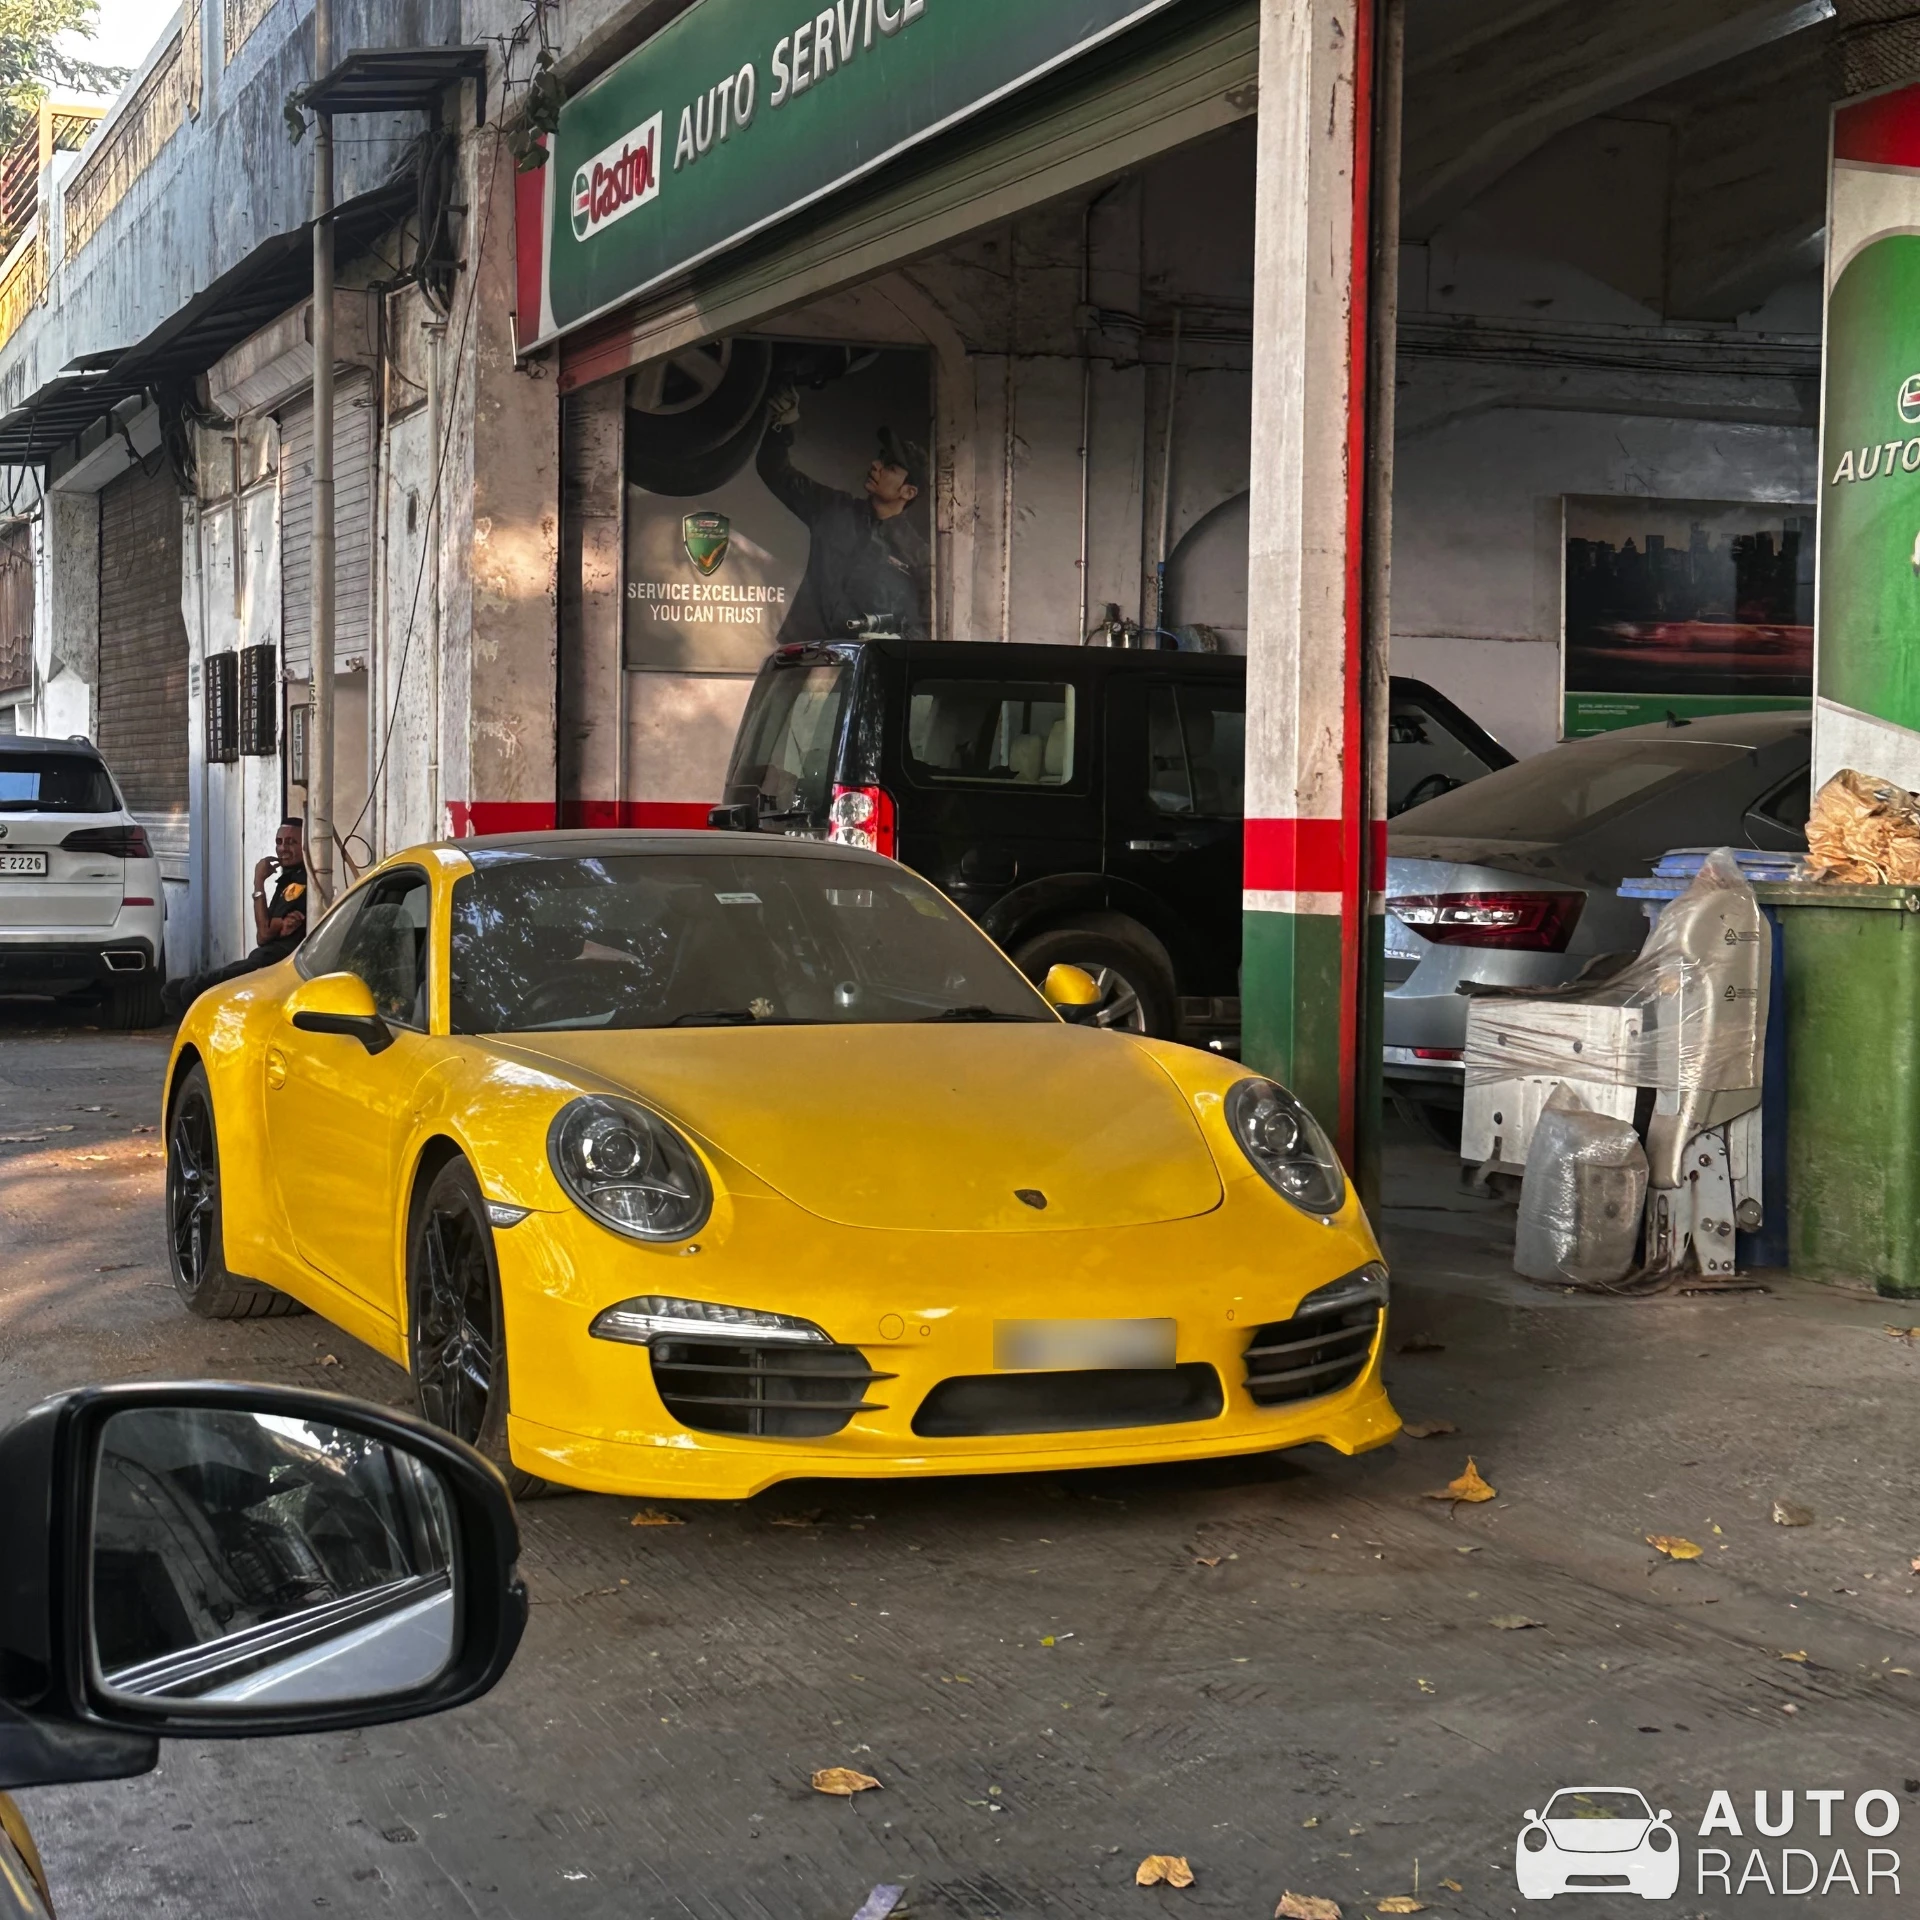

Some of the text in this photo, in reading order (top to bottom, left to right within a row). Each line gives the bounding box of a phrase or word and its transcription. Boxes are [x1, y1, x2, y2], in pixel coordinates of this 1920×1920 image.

[591, 0, 924, 224] Castrol AUTO SERVI
[1831, 437, 1920, 485] AUTO
[627, 582, 785, 603] SERVICE EXCELLENCE
[650, 604, 763, 624] YOU CAN TRUST
[10, 857, 41, 870] 2226
